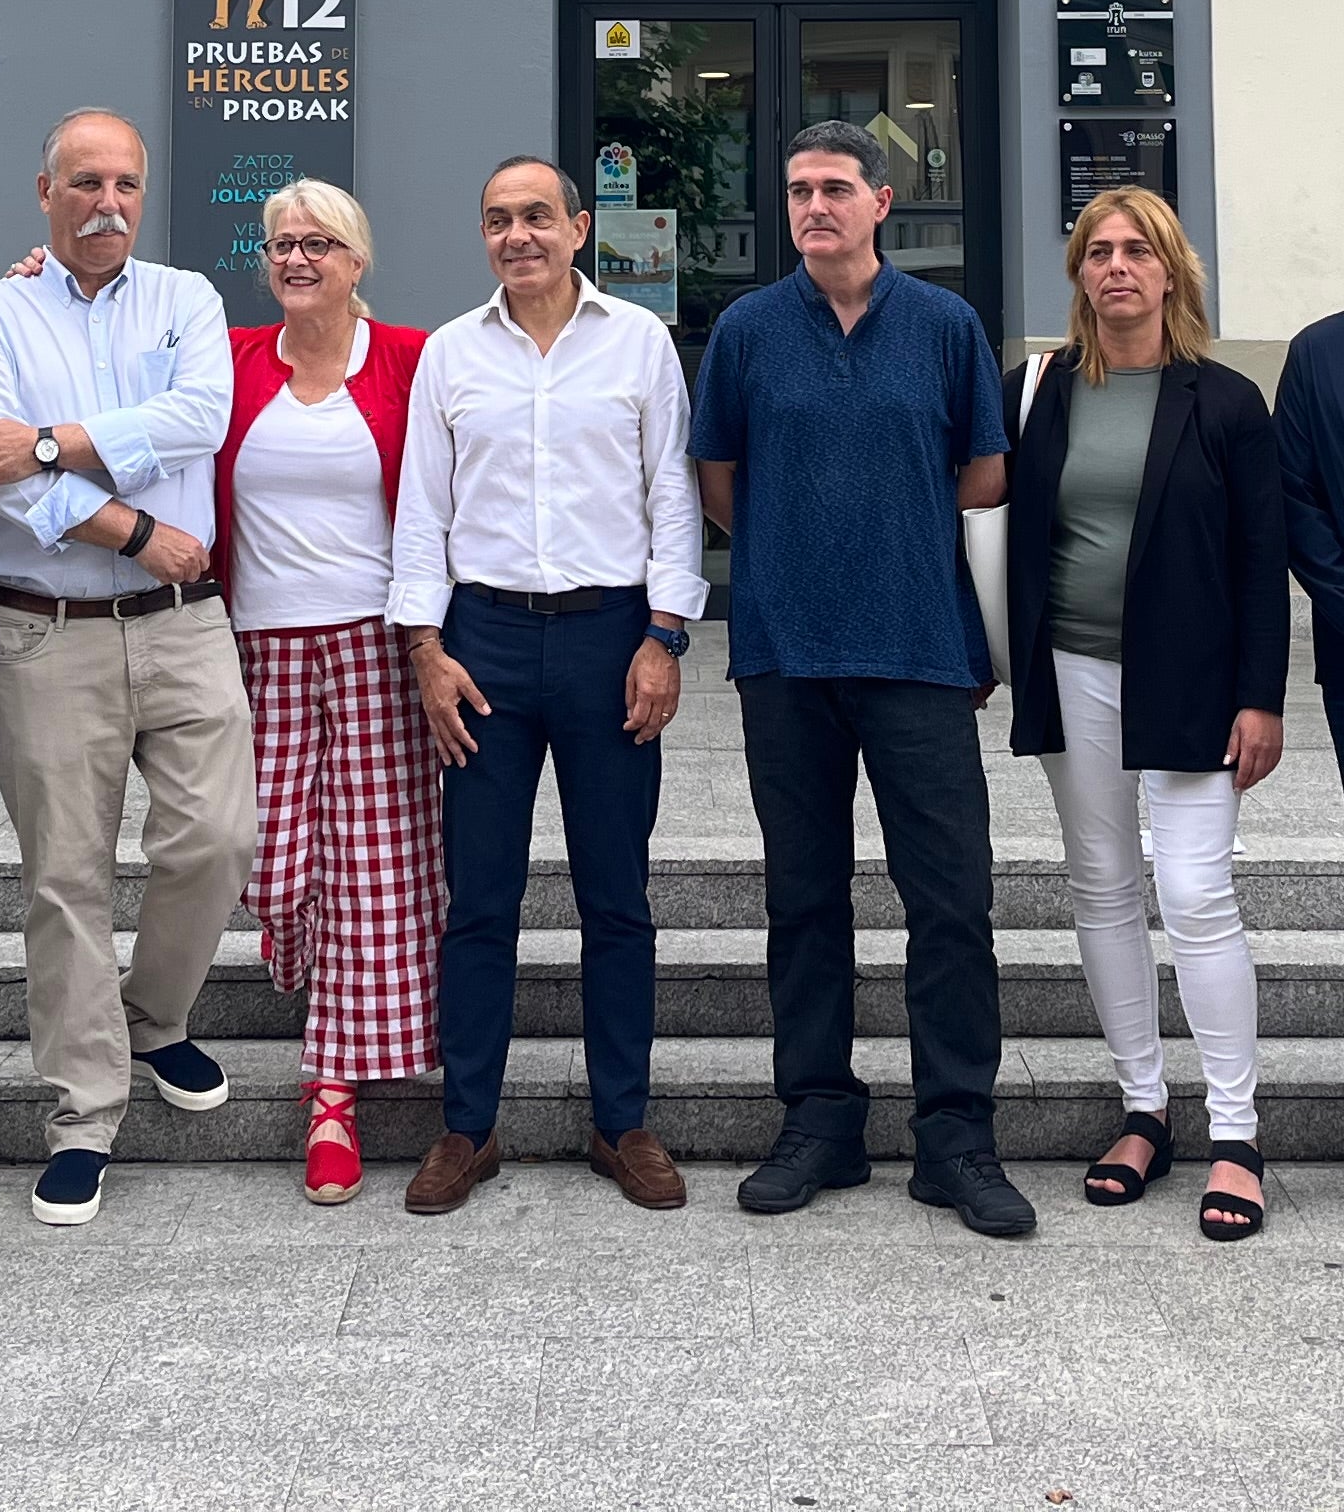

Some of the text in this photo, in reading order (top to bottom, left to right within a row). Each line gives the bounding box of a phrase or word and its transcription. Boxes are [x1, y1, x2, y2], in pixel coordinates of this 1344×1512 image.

[187, 41, 350, 64] PRUEBAS DE
[187, 63, 349, 92] HÉRCULES
[223, 99, 349, 121] PROBAK
[233, 155, 294, 168] ZATOZ
[218, 172, 307, 186] MUSEORA
[210, 189, 280, 203] JOLAST
[215, 258, 235, 271] AL
